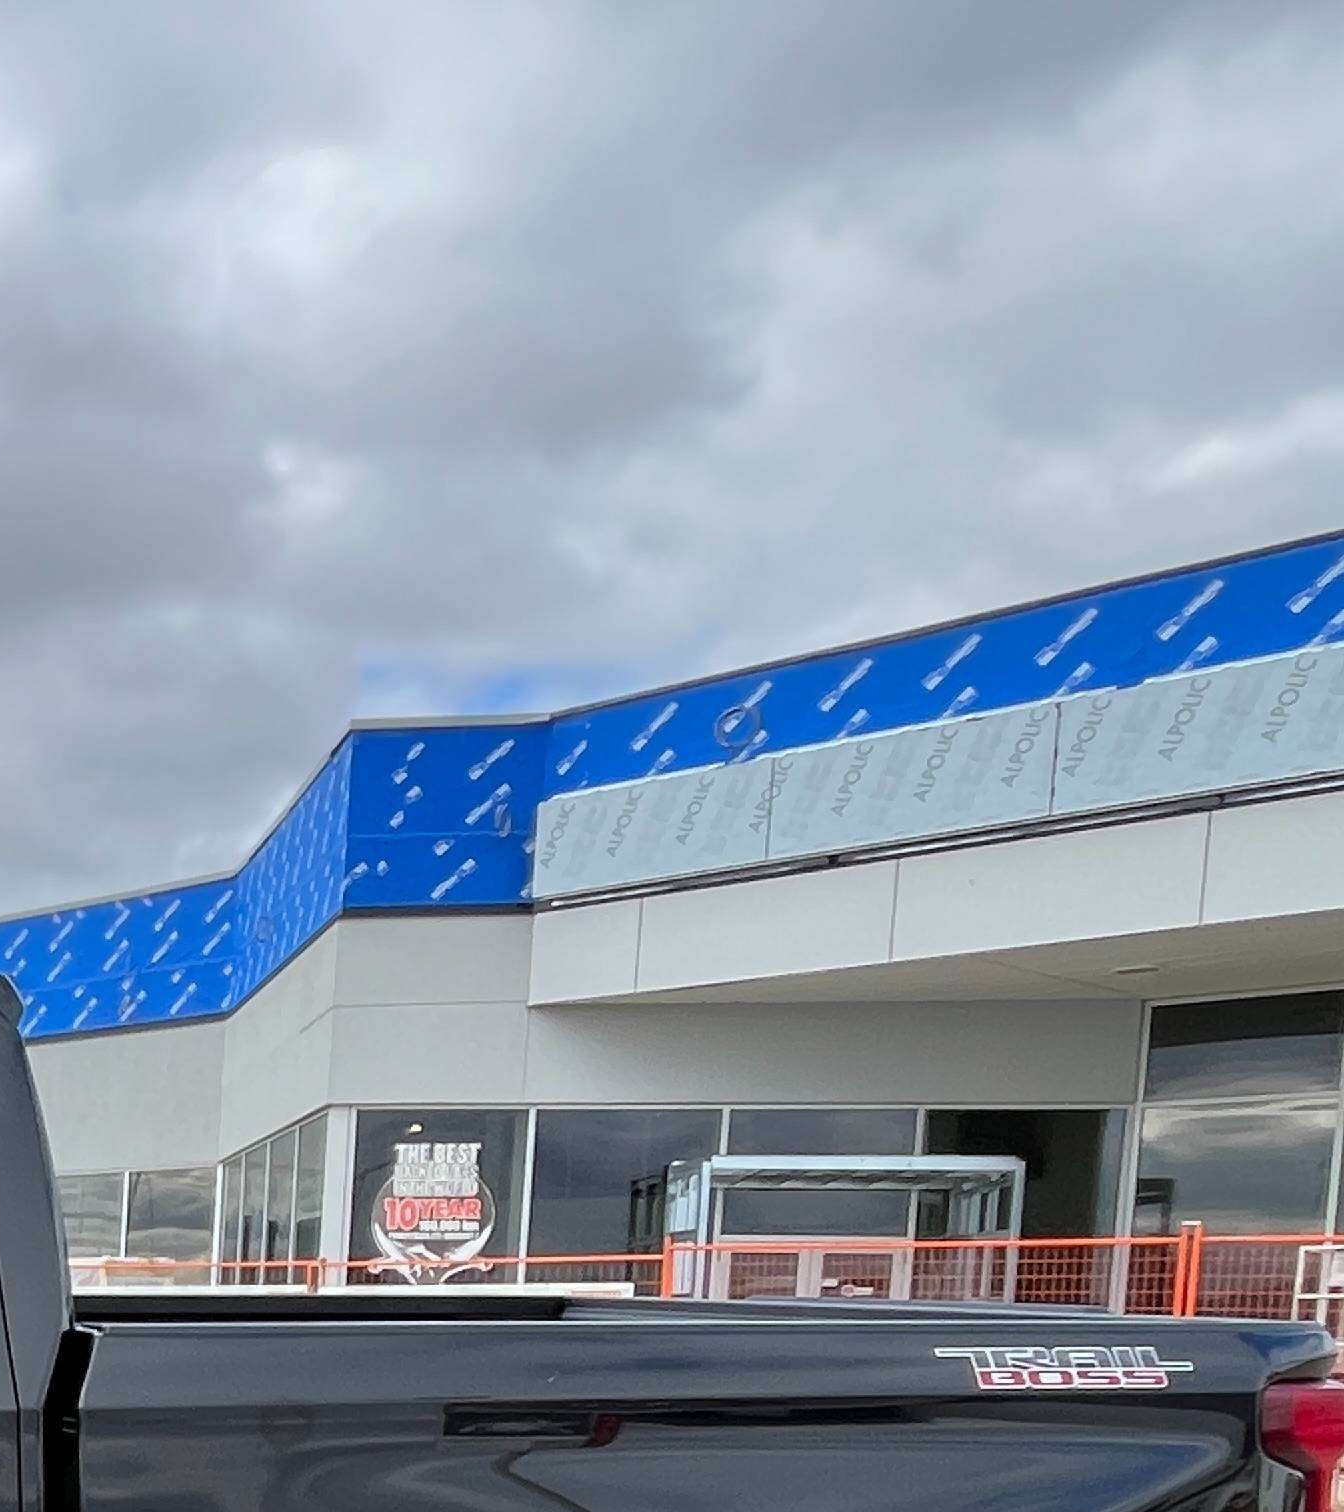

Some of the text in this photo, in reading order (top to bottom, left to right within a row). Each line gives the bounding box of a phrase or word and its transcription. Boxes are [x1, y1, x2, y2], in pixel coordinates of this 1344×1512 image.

[1158, 676, 1213, 762] ALPOLIC
[1261, 653, 1318, 743] ALPOLIC
[913, 727, 959, 802] ALPOLIC
[1000, 709, 1050, 788] ALPOLIC
[1062, 697, 1112, 778] ALPOLIC
[674, 774, 716, 845] ALPOLIC
[830, 743, 874, 817] ALPOLIC
[606, 790, 644, 857] ALPOLIC
[395, 1143, 481, 1163] THE BEST
[934, 1346, 1193, 1371] TRAIL
[975, 1367, 1169, 1389] BOSS
